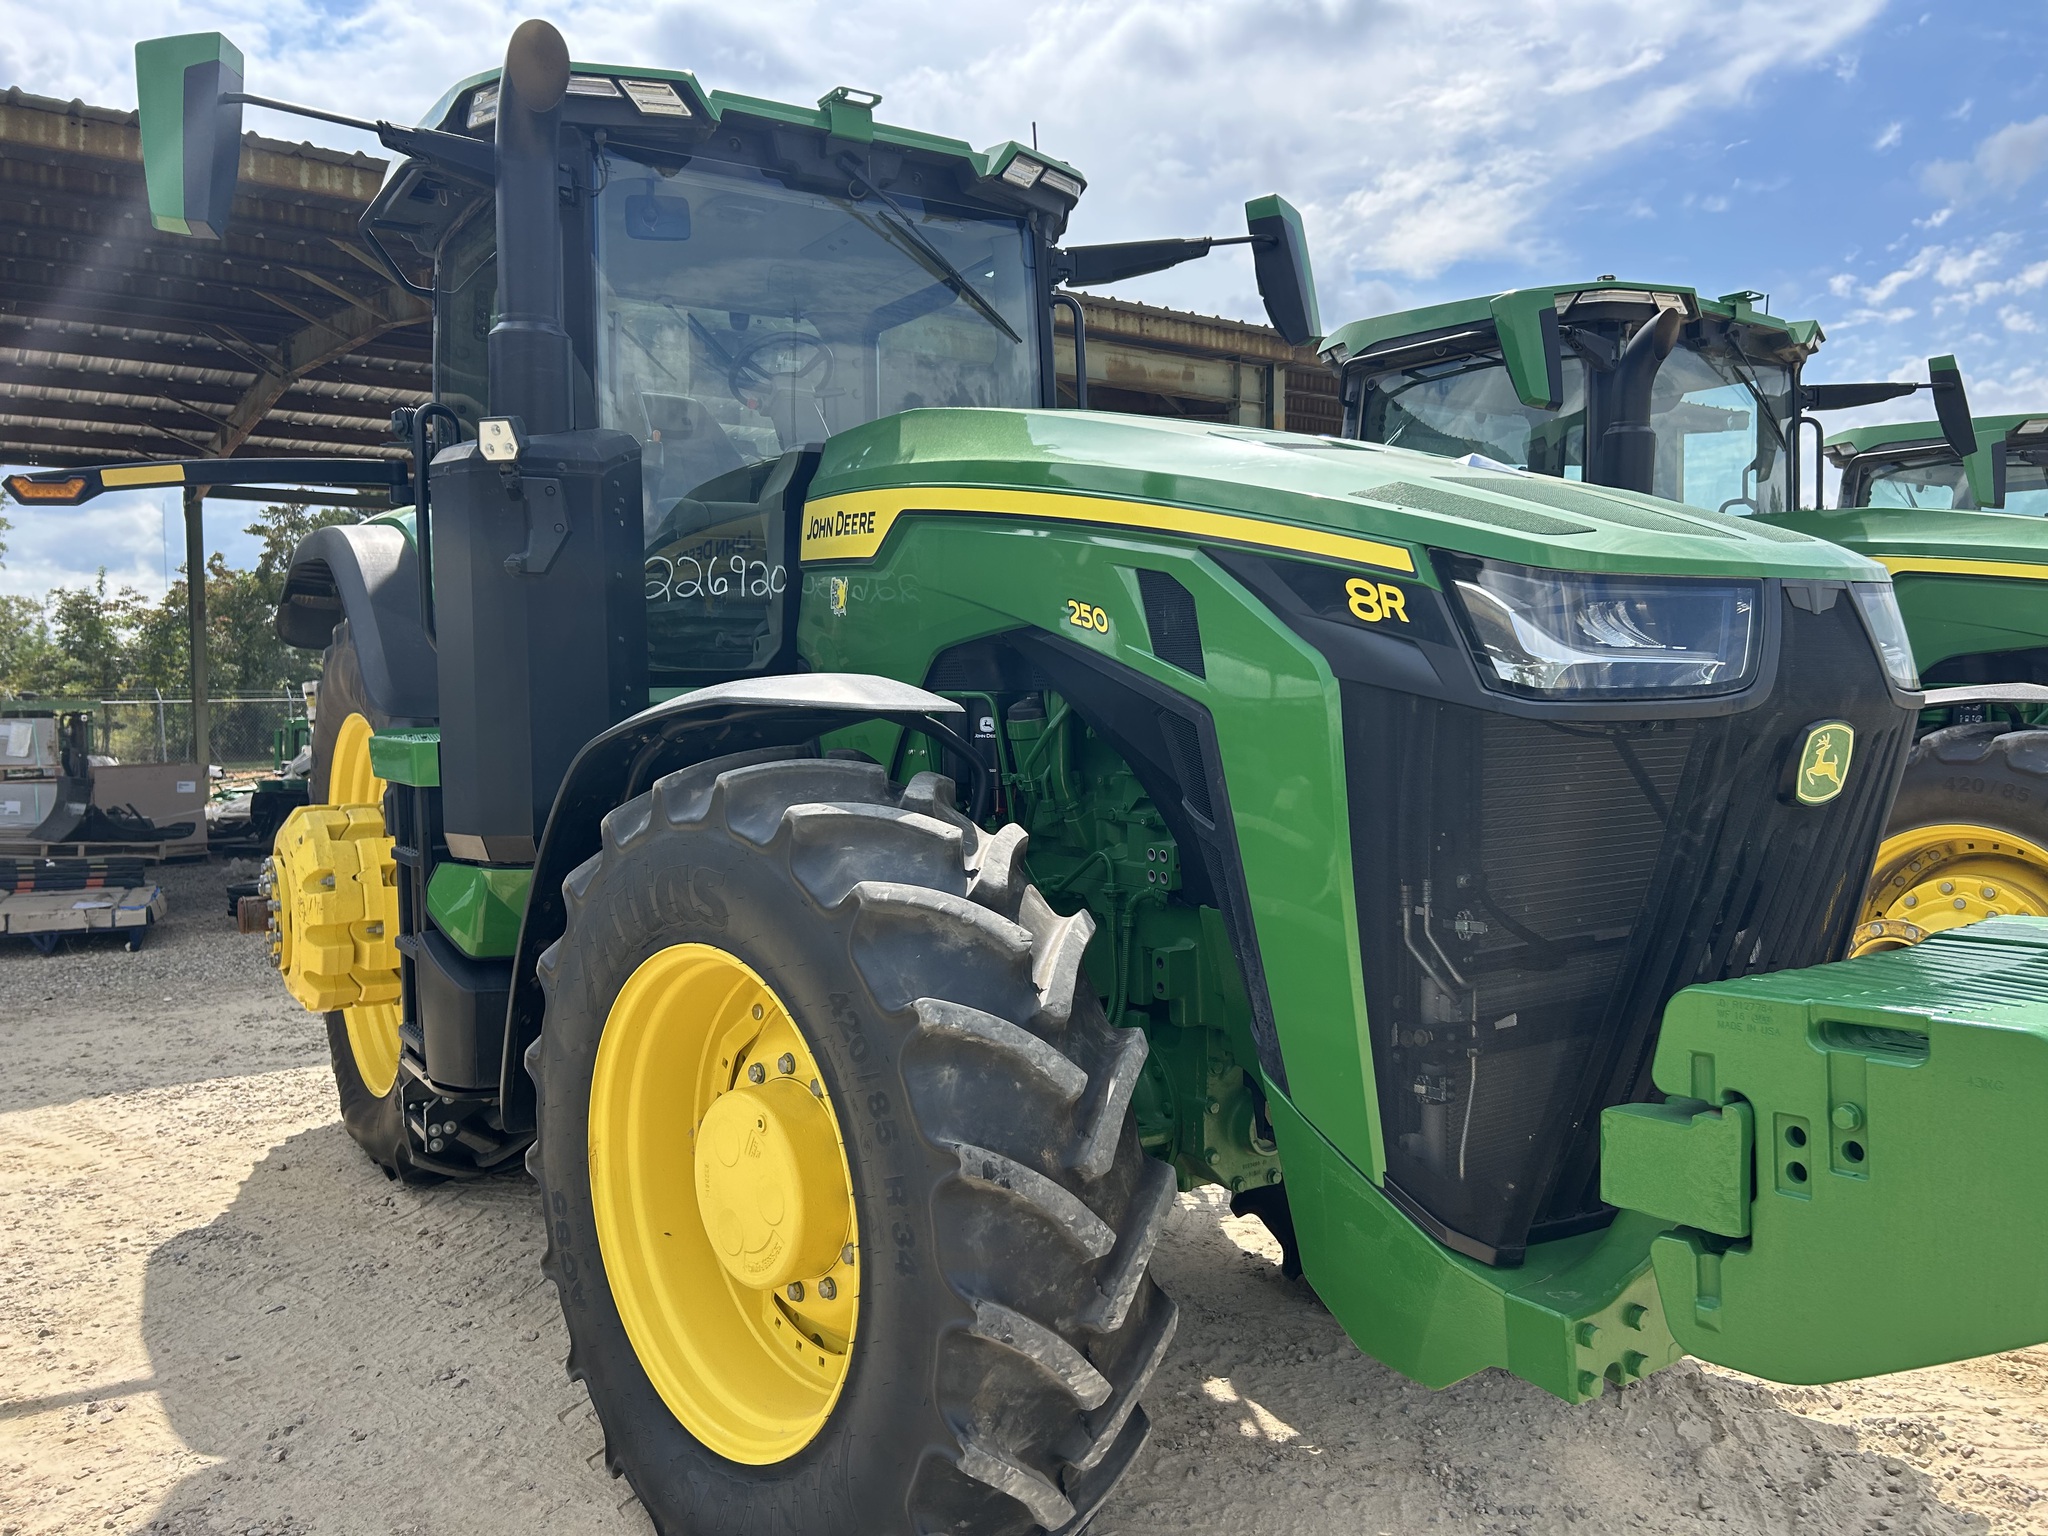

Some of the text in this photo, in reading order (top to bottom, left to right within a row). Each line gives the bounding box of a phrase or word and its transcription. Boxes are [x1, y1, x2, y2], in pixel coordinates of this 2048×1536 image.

[806, 510, 876, 541] JOHN DEERE
[644, 556, 787, 602] 226920
[1066, 598, 1110, 635] 250
[1345, 577, 1411, 623] 8R
[1717, 1020, 1743, 1032] MADE
[1760, 1026, 1781, 1037] USA
